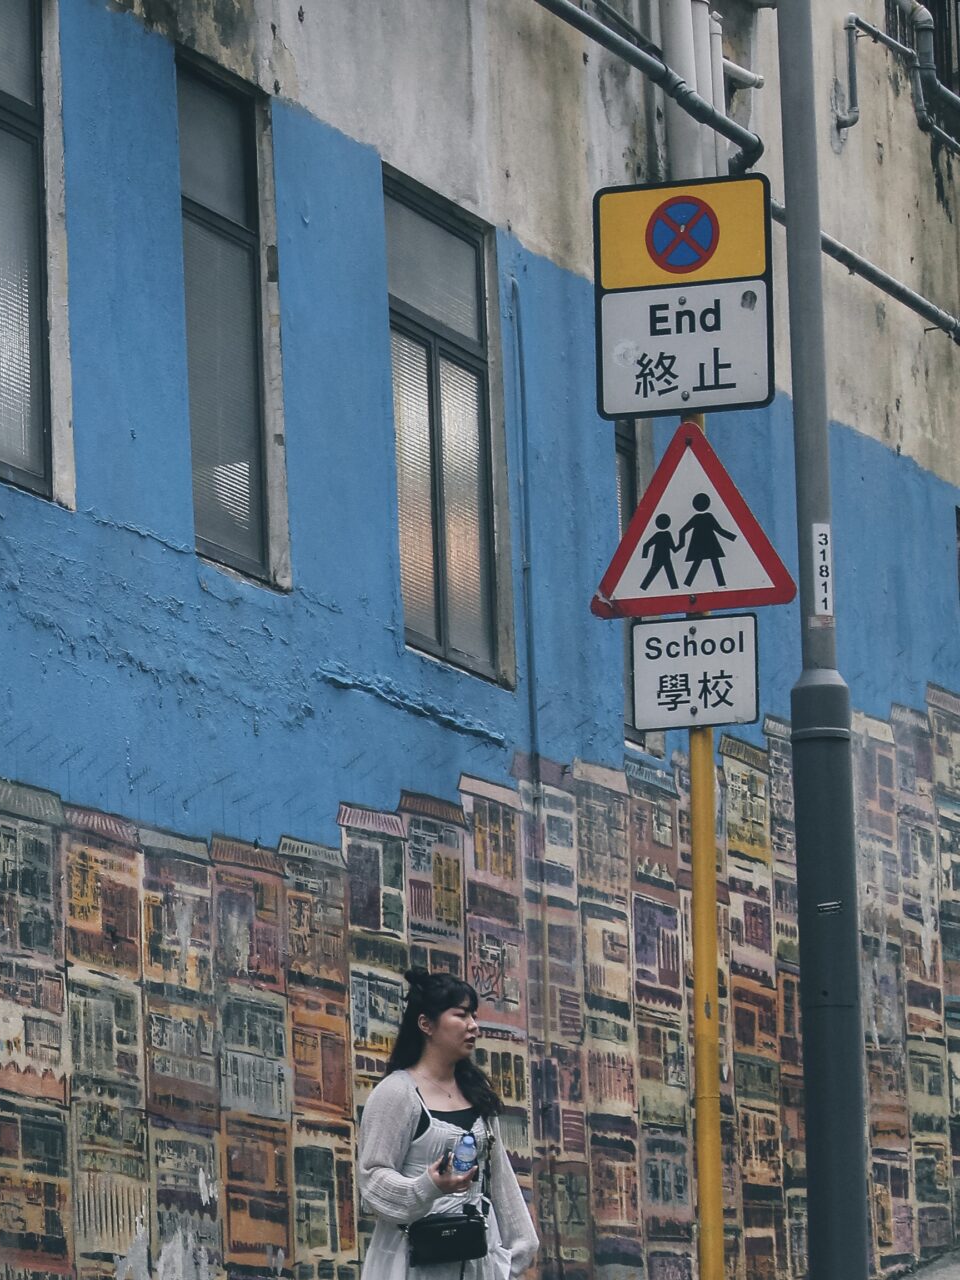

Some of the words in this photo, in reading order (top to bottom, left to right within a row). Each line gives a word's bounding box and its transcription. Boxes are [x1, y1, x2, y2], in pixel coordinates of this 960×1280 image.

[649, 299, 721, 336] End
[634, 347, 737, 398] 終止
[818, 533, 829, 610] 31811
[645, 631, 744, 660] School
[656, 669, 734, 711] 學校
